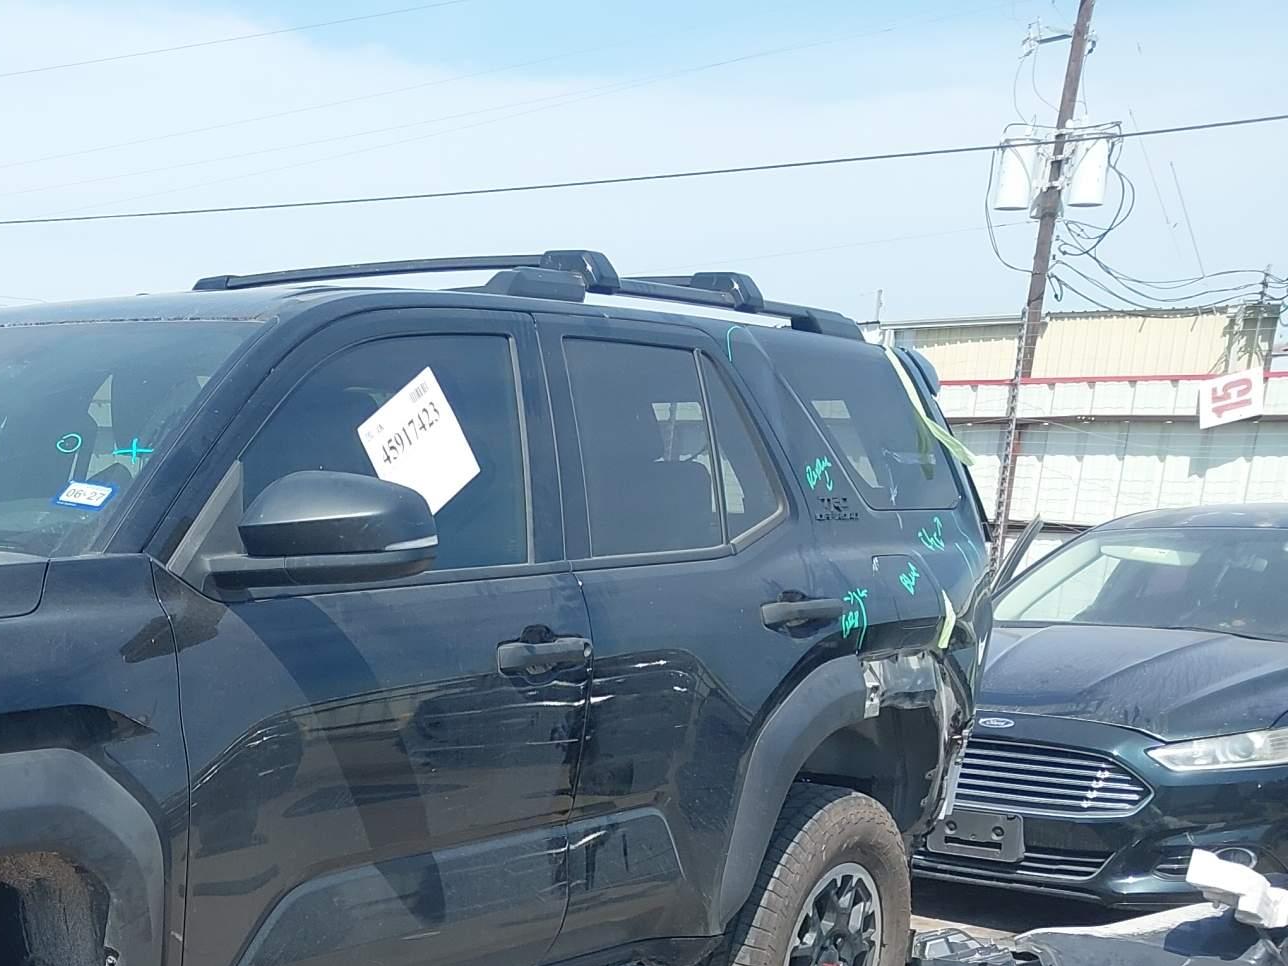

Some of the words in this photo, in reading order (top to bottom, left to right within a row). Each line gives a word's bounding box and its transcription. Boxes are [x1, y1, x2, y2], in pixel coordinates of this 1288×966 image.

[1211, 378, 1253, 418] 15
[381, 401, 441, 465] 45917423
[66, 488, 83, 499] 06
[86, 491, 106, 501] 27
